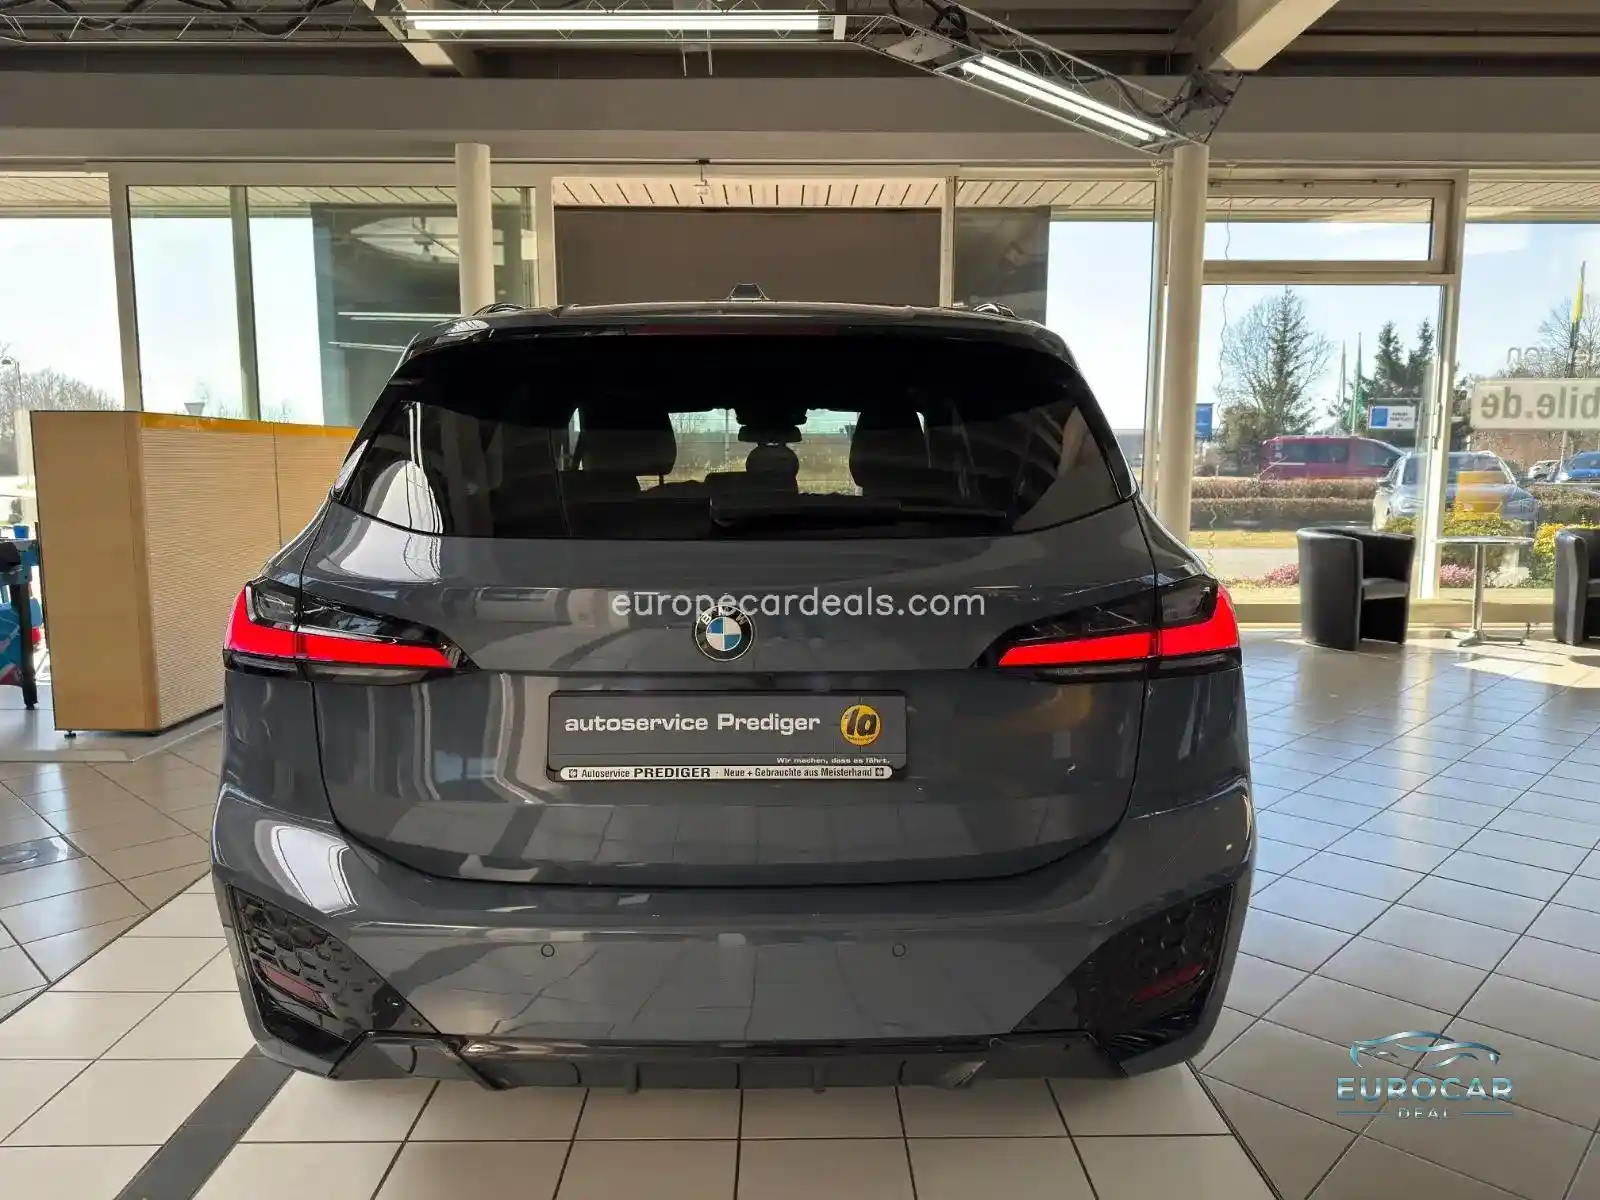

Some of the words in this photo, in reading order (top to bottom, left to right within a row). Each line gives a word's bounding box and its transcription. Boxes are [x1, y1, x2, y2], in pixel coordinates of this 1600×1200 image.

[564, 714, 709, 732] autoservice
[717, 713, 821, 736] Prediger
[581, 769, 630, 778] Autoservice
[634, 767, 711, 778] PREDIGER
[723, 768, 745, 777] Neue
[755, 767, 802, 777] Gebrauchte
[804, 768, 818, 777] aus
[821, 767, 872, 777] Meisterhand
